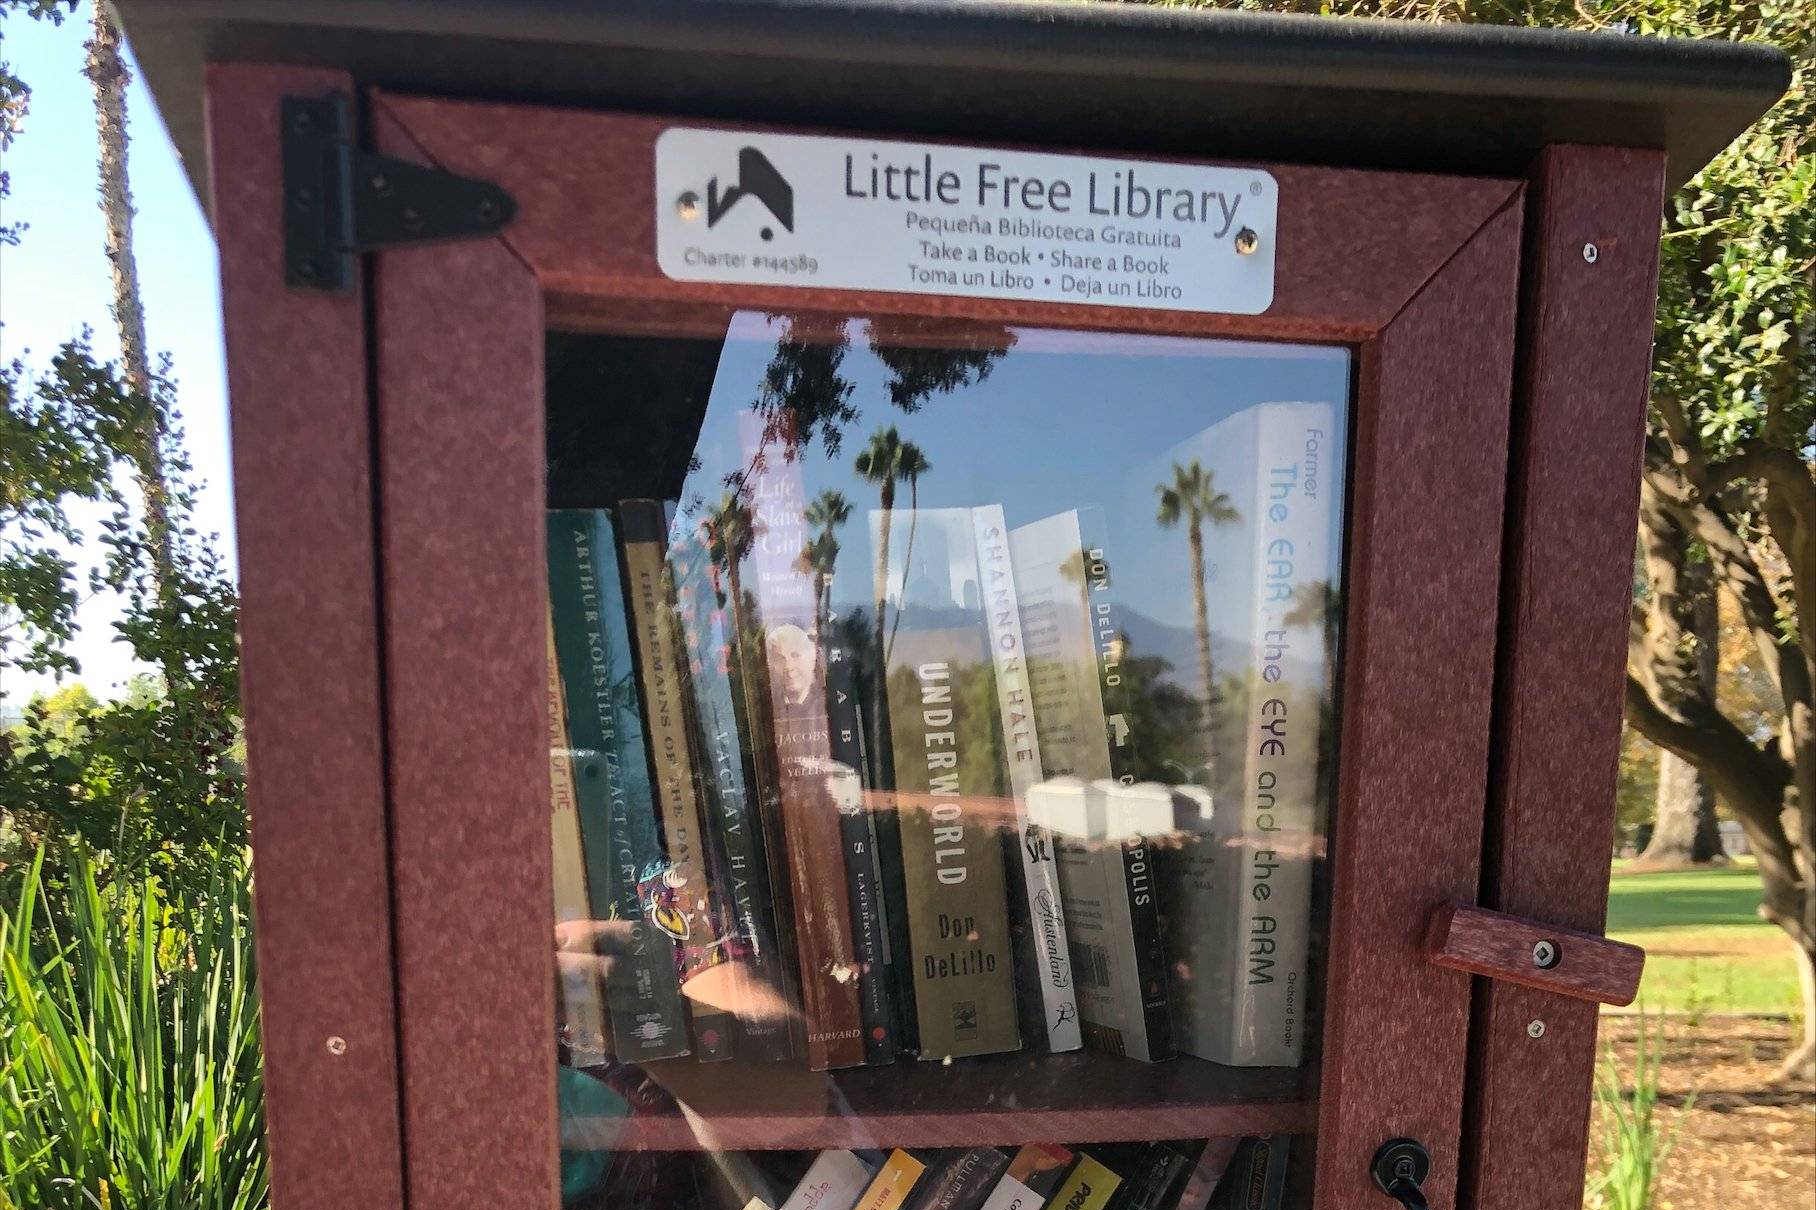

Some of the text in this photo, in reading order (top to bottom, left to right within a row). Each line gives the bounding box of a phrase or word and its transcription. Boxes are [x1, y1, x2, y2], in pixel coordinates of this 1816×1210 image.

[845, 154, 961, 204] Little
[978, 164, 1072, 212] Free
[906, 211, 1181, 249] Pequeña Biblioteca Gratuita
[920, 240, 1169, 275] Take a Book Share a Book
[909, 266, 1183, 299] Toma un Libro Deja un Libro
[1267, 463, 1297, 523] The
[1089, 547, 1108, 592] DON
[573, 529, 616, 740] ARTHUR KOESTLER
[984, 525, 1032, 762] SHANNON HALE
[1263, 629, 1288, 685] the
[647, 624, 672, 728] REMAINS
[664, 736, 679, 766] OF
[779, 731, 828, 745] JACOBS
[1258, 698, 1286, 756] EYE
[919, 662, 967, 885] UNDERWORLD
[1256, 771, 1281, 832] and
[607, 783, 629, 824] ACT
[1252, 851, 1279, 902] the
[938, 914, 975, 939] Don
[1246, 913, 1278, 987] ARM
[925, 946, 996, 979] DeLillo
[807, 1027, 860, 1043] HARVARD
[936, 1151, 981, 1210] PULLMAN
